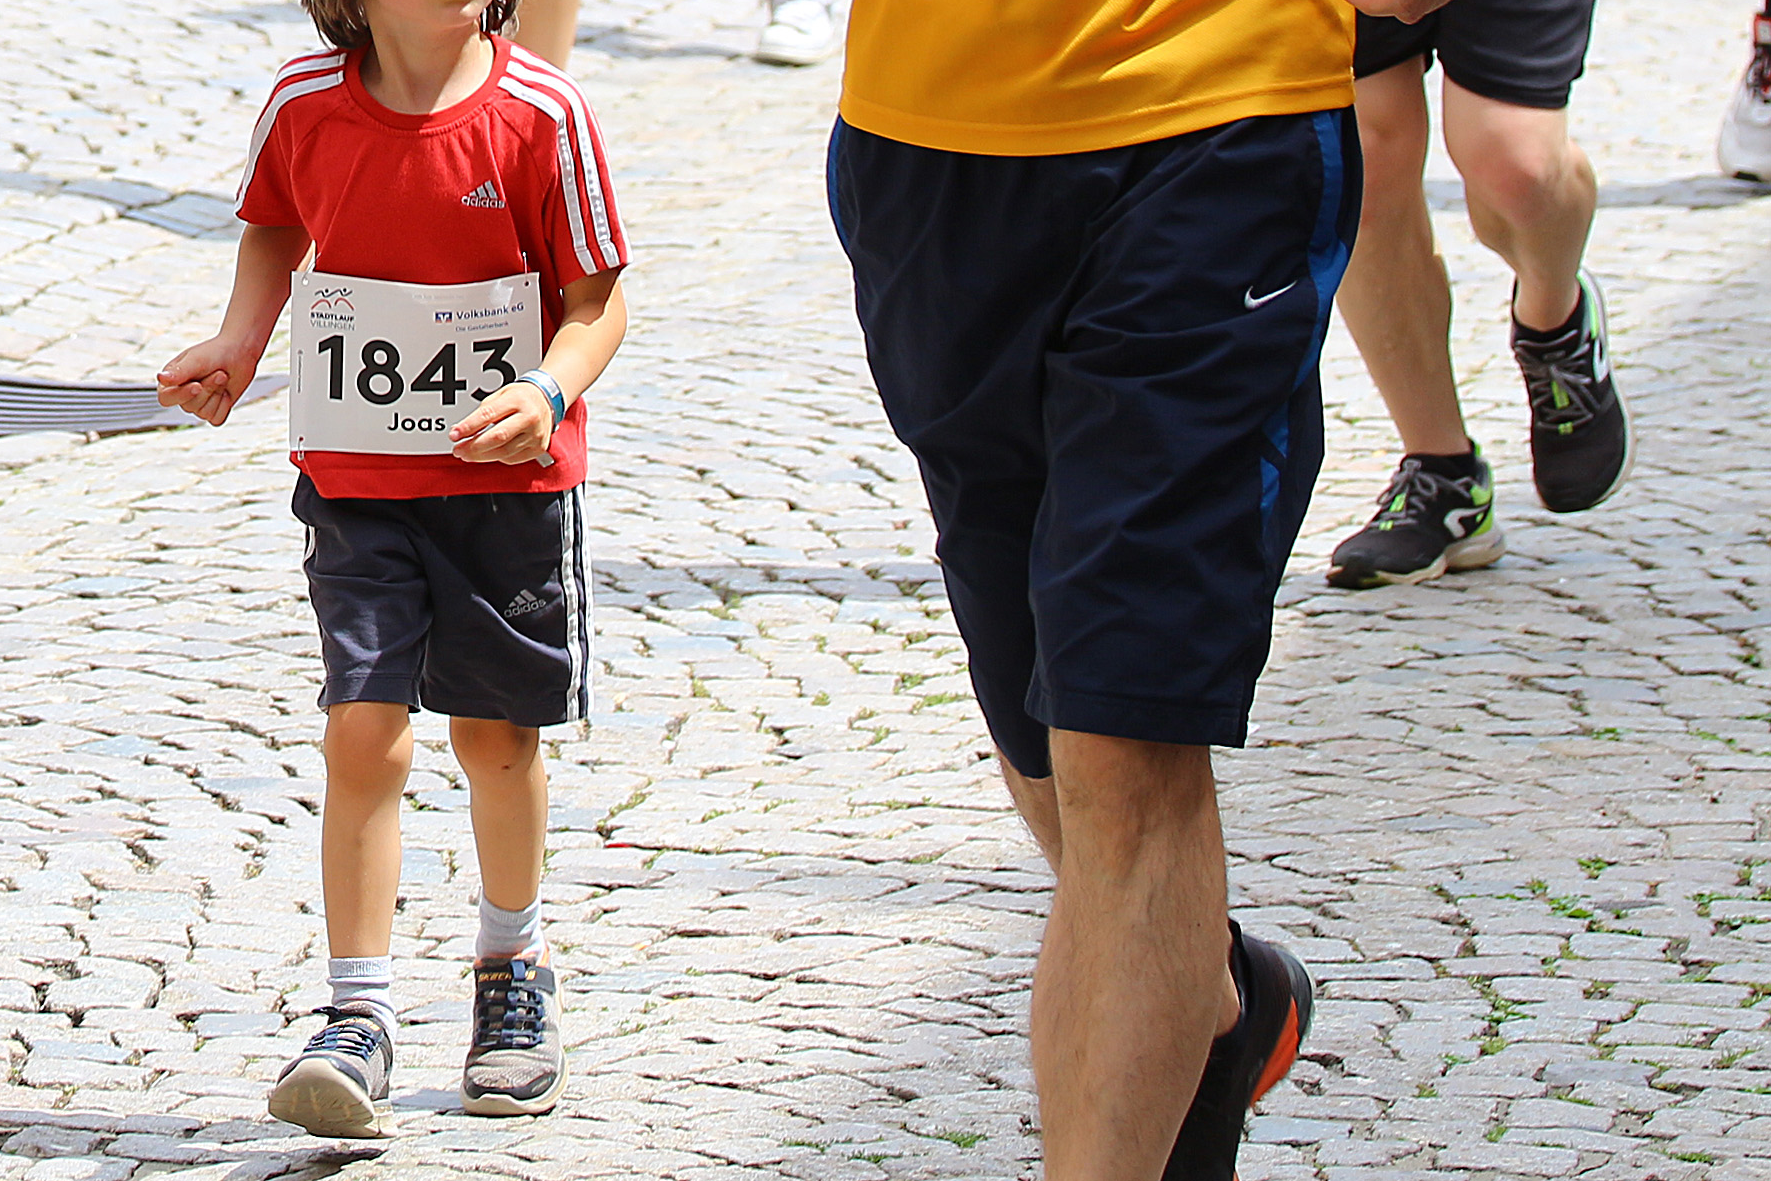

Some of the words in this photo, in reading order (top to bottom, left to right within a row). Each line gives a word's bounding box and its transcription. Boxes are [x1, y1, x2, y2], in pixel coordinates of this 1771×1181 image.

[461, 195, 506, 209] adidas
[310, 311, 356, 323] STADTLAUF
[456, 304, 509, 320] Volksbank
[511, 301, 525, 313] eG
[310, 319, 356, 332] VILLINGEN
[317, 334, 518, 406] 1843
[387, 412, 447, 432] Joas
[503, 598, 547, 618] adidas
